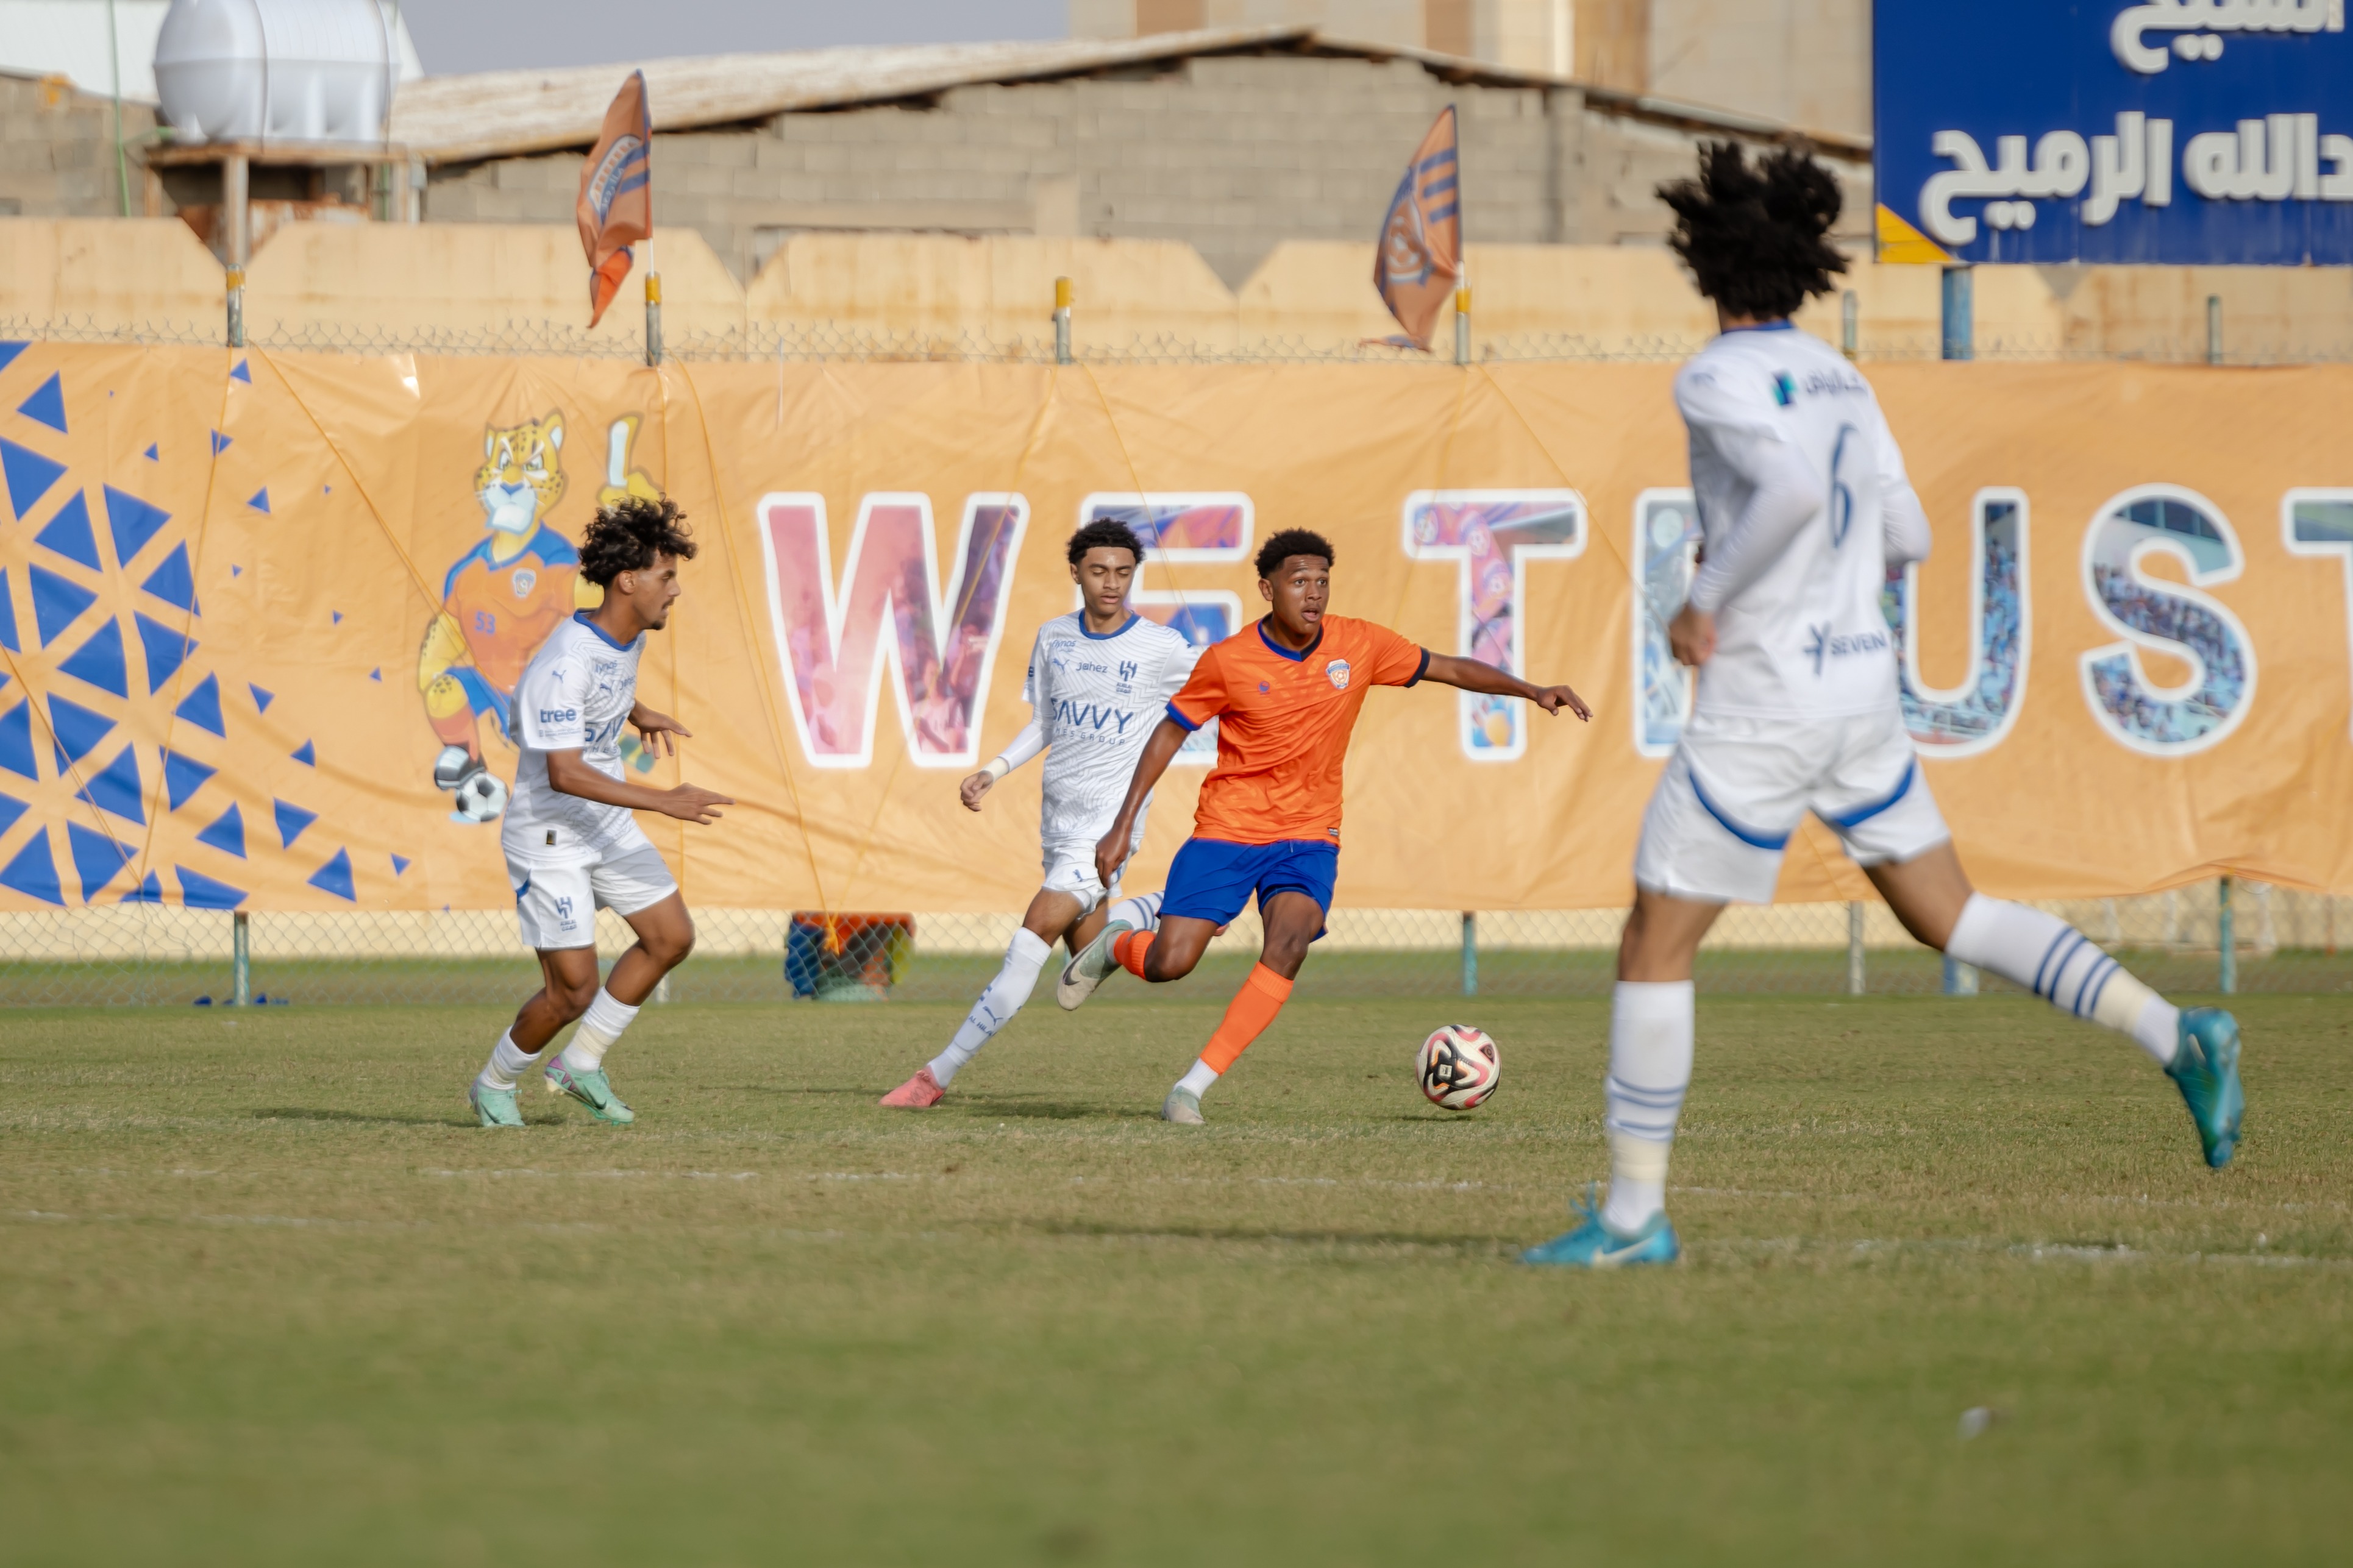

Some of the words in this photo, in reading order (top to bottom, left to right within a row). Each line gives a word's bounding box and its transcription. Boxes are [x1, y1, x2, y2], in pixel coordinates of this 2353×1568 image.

[1918, 110, 2173, 245] الرميح
[1828, 420, 1860, 547] 6
[475, 611, 496, 634] 53
[1831, 631, 1888, 656] SEVEN
[539, 708, 577, 723] tree
[1050, 697, 1134, 734] SAVVY
[1080, 732, 1126, 746] GROUP
